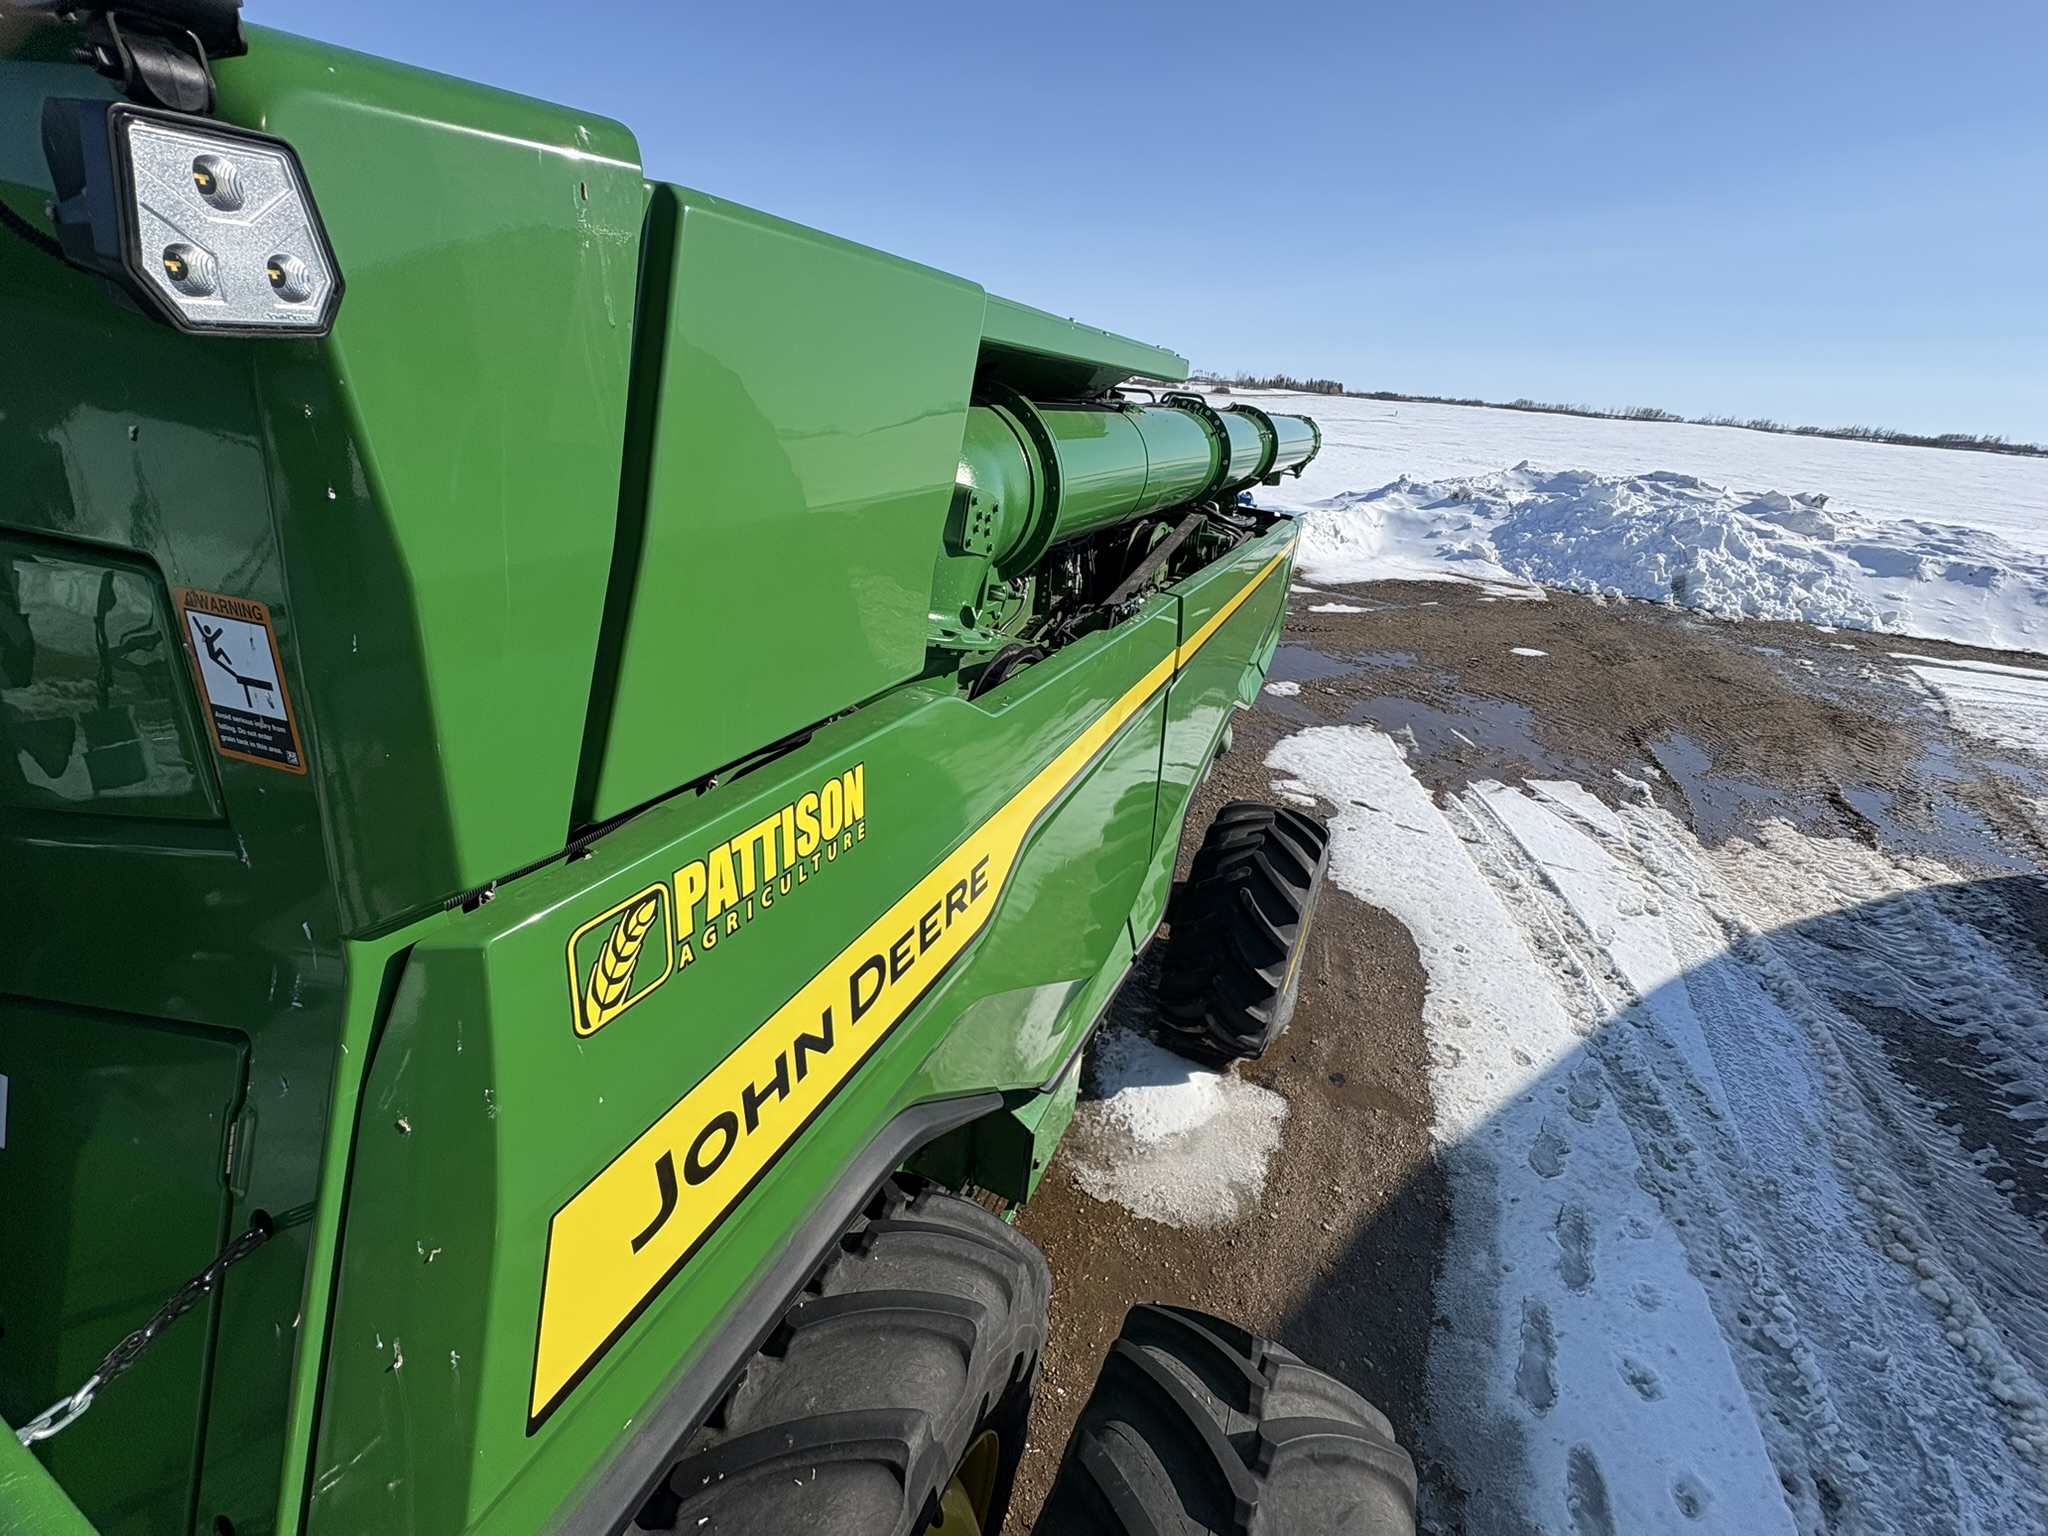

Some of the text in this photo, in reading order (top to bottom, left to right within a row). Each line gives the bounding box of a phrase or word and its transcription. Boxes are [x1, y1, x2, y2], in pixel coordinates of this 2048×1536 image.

[200, 596, 263, 621] WARNING
[215, 711, 286, 733] Avoid serious injury from
[238, 727, 247, 735] Do
[247, 730, 257, 738] not
[257, 733, 273, 741] enter
[236, 738, 249, 746] tank
[256, 743, 268, 751] this
[672, 761, 867, 945] PATTISON
[676, 819, 867, 974] AGRICULTURE
[631, 853, 991, 1255] JOHN DEERE
